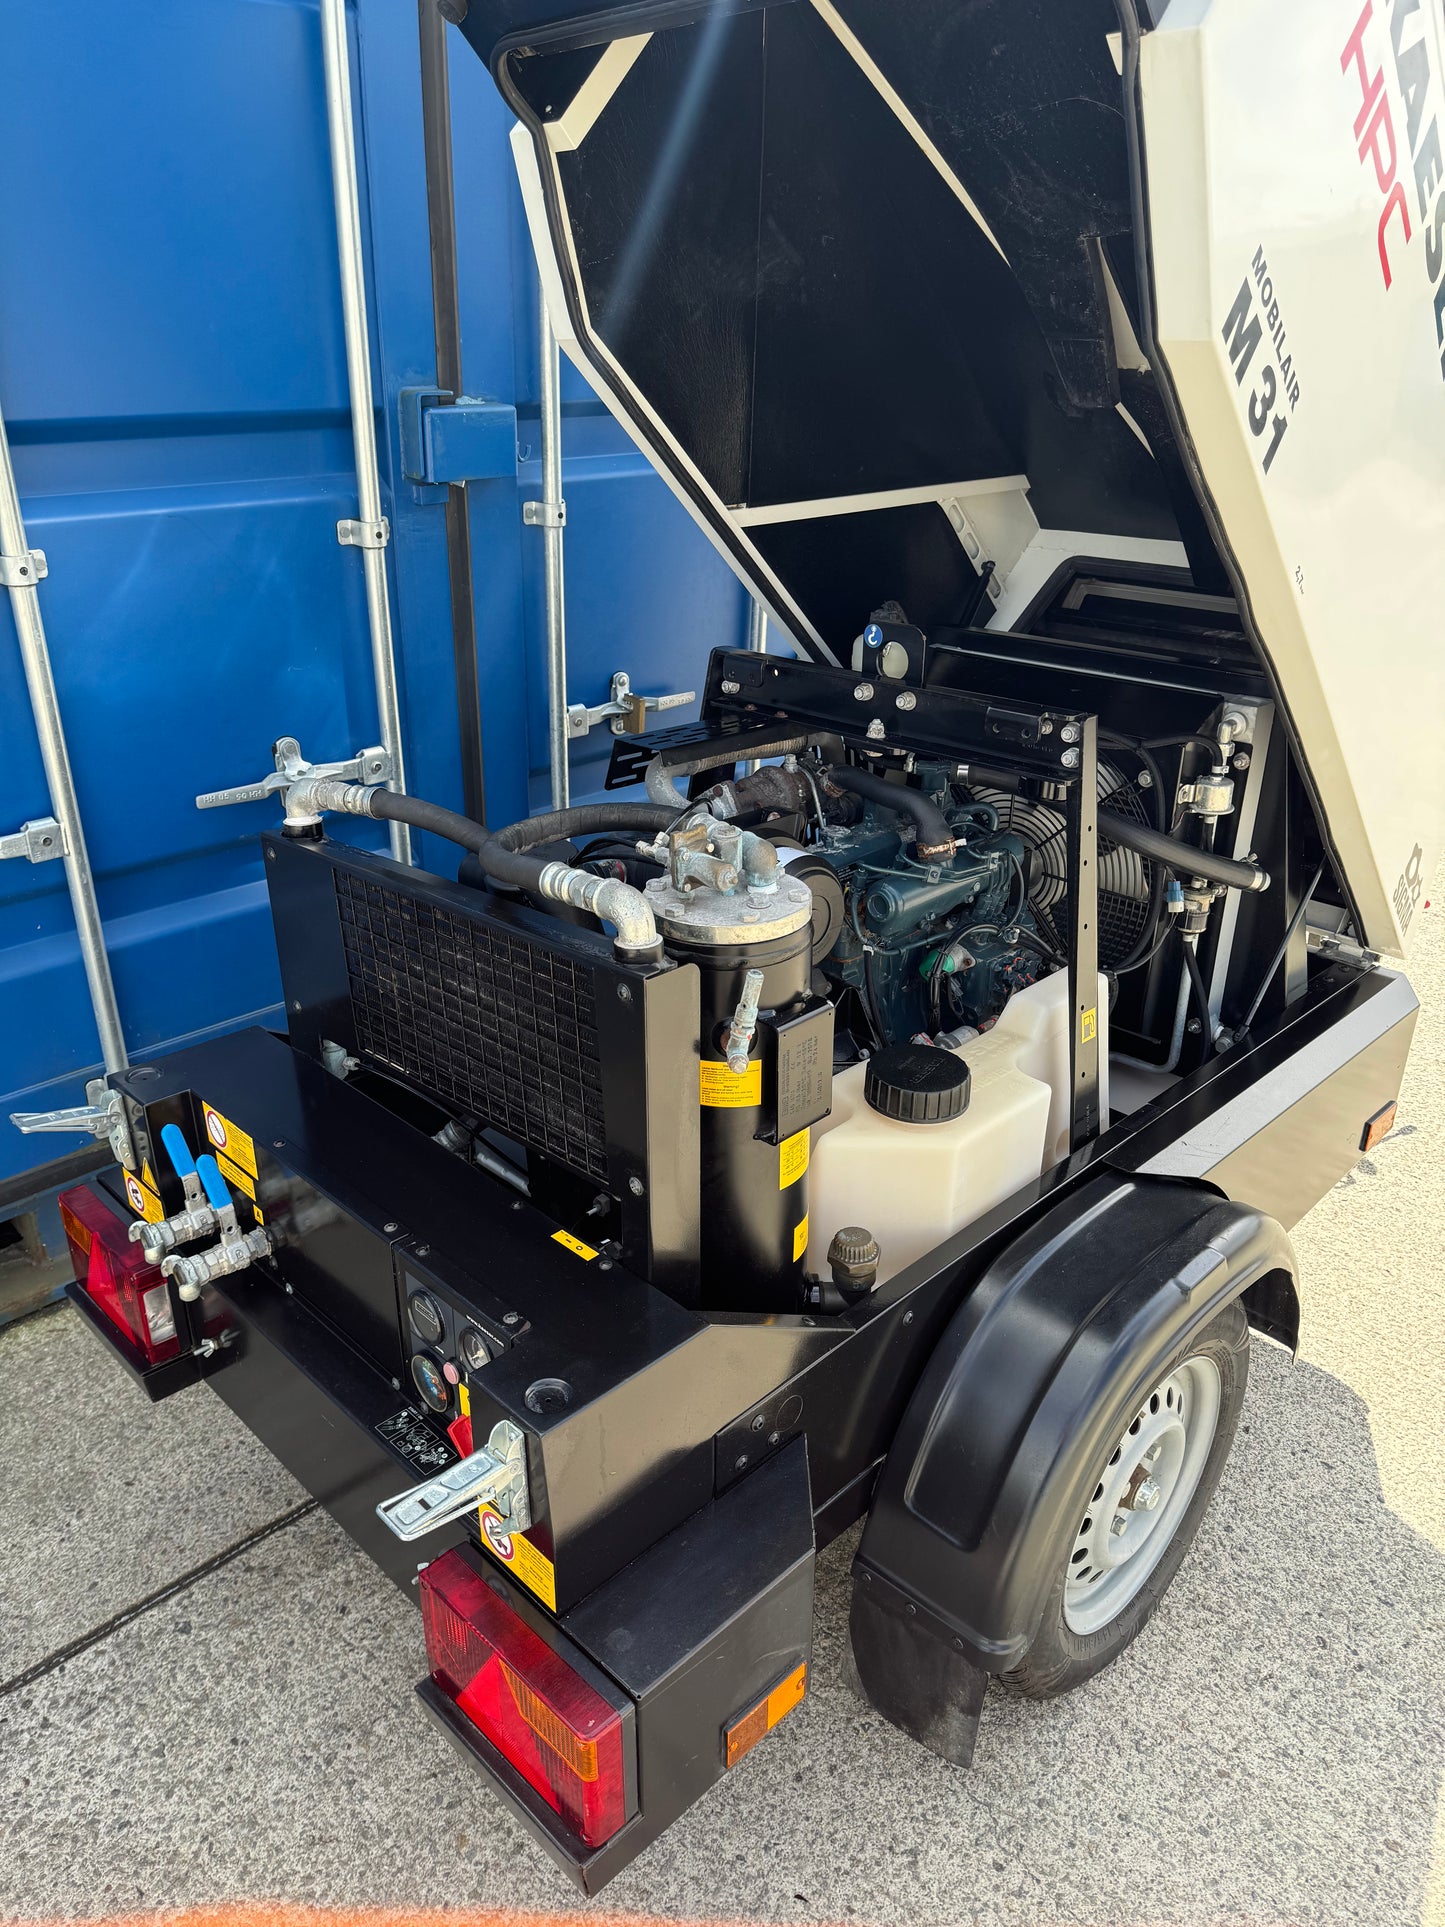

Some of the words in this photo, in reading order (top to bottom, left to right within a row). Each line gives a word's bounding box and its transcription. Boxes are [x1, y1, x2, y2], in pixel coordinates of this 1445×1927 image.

[1339, 0, 1412, 292] HPC
[1221, 276, 1263, 387] M
[1248, 364, 1288, 475] 31
[1251, 243, 1300, 413] MOBILAIR
